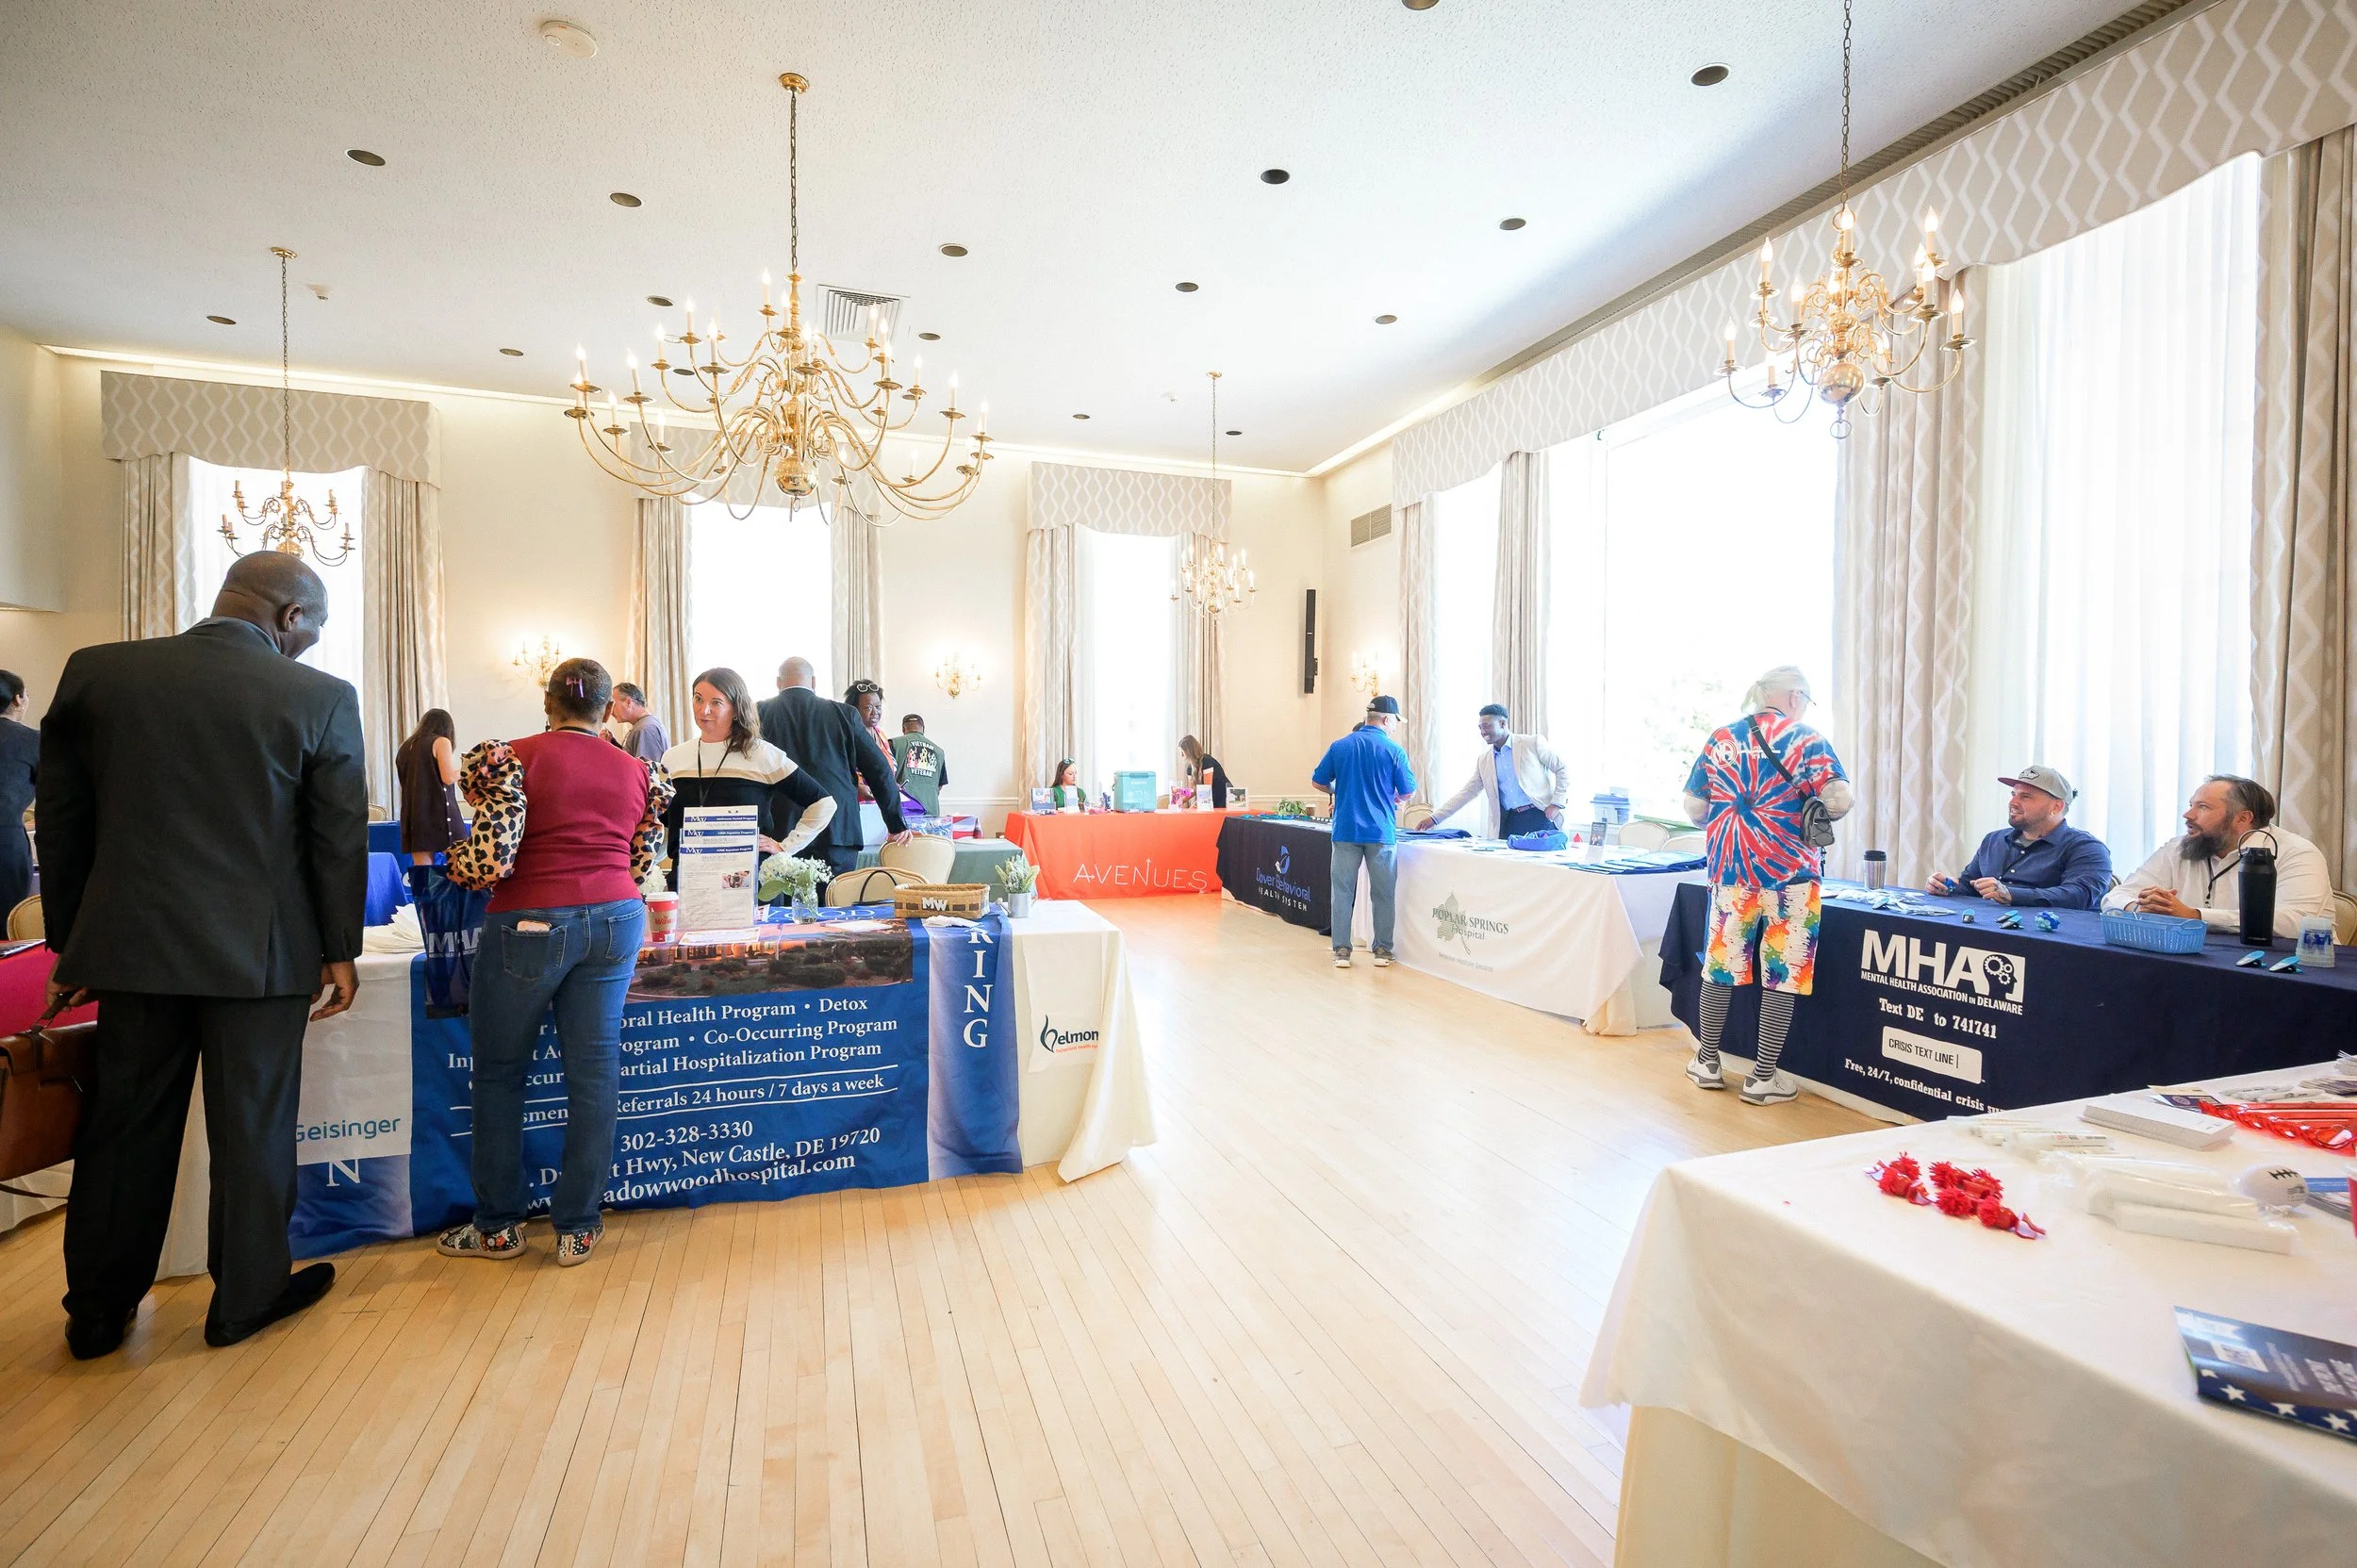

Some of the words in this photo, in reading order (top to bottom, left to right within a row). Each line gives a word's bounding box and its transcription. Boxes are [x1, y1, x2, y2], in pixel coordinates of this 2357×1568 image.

[1073, 858, 1208, 890] AVENUES
[922, 897, 948, 912] MW
[1432, 907, 1467, 926] POPLAR
[1469, 916, 1508, 934] SPRINGS
[1861, 970, 1888, 985] MENTAL
[1888, 977, 1917, 992] HEALTH
[1918, 983, 1968, 1003] ASSOCIATION
[1977, 996, 2023, 1015] DELAWARE
[658, 1006, 717, 1025] Health
[721, 1003, 796, 1021] Program
[818, 997, 868, 1014] Detox
[1879, 998, 1903, 1015] Text
[1906, 1004, 1924, 1021] DE
[1934, 1013, 1947, 1027] to
[1953, 1015, 1997, 1039] 741741
[703, 1023, 824, 1046] Co-Occurring
[827, 1018, 898, 1036] Program
[620, 1058, 668, 1077] artial
[672, 1049, 806, 1073] Hospitalization
[810, 1043, 882, 1062] Program
[1888, 1038, 1913, 1054] CRISIS
[1914, 1044, 1933, 1059] TEXT
[1935, 1050, 1954, 1065] LINE
[692, 1090, 712, 1105] 24
[716, 1085, 766, 1103] hours
[778, 1083, 787, 1098] 7
[791, 1079, 829, 1098] days
[832, 1081, 841, 1093] a
[844, 1074, 884, 1089] week
[1845, 1058, 1866, 1076] Free,
[1868, 1065, 1893, 1084] 24/7,
[1894, 1076, 1952, 1101] confidential
[1955, 1095, 1985, 1112] crisis
[297, 1118, 400, 1142] Geisinger
[620, 1119, 754, 1153] 302-328-3330
[627, 1157, 677, 1176] Hwy,
[682, 1147, 724, 1168] New
[729, 1141, 791, 1163] Castle,
[795, 1140, 825, 1158] DE
[831, 1127, 882, 1153] 19720
